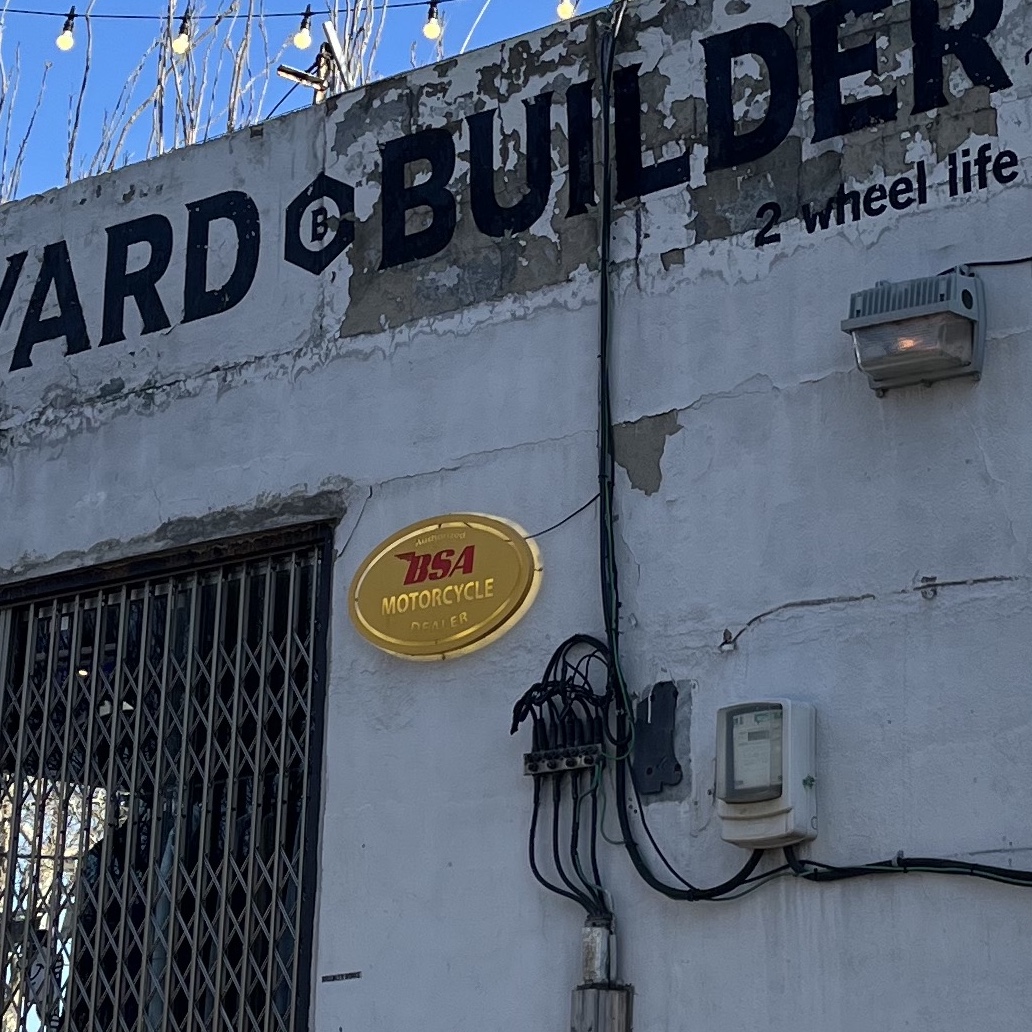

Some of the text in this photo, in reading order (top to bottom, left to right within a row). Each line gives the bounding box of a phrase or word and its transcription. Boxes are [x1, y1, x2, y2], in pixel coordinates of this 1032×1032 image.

[310, 206, 328, 243] B
[378, 0, 1012, 271] BUILDER
[754, 143, 1019, 247] 2 wheel life
[394, 545, 475, 586] BSA
[381, 578, 494, 615] MOTORCYCLE
[411, 611, 468, 631] DEALER
